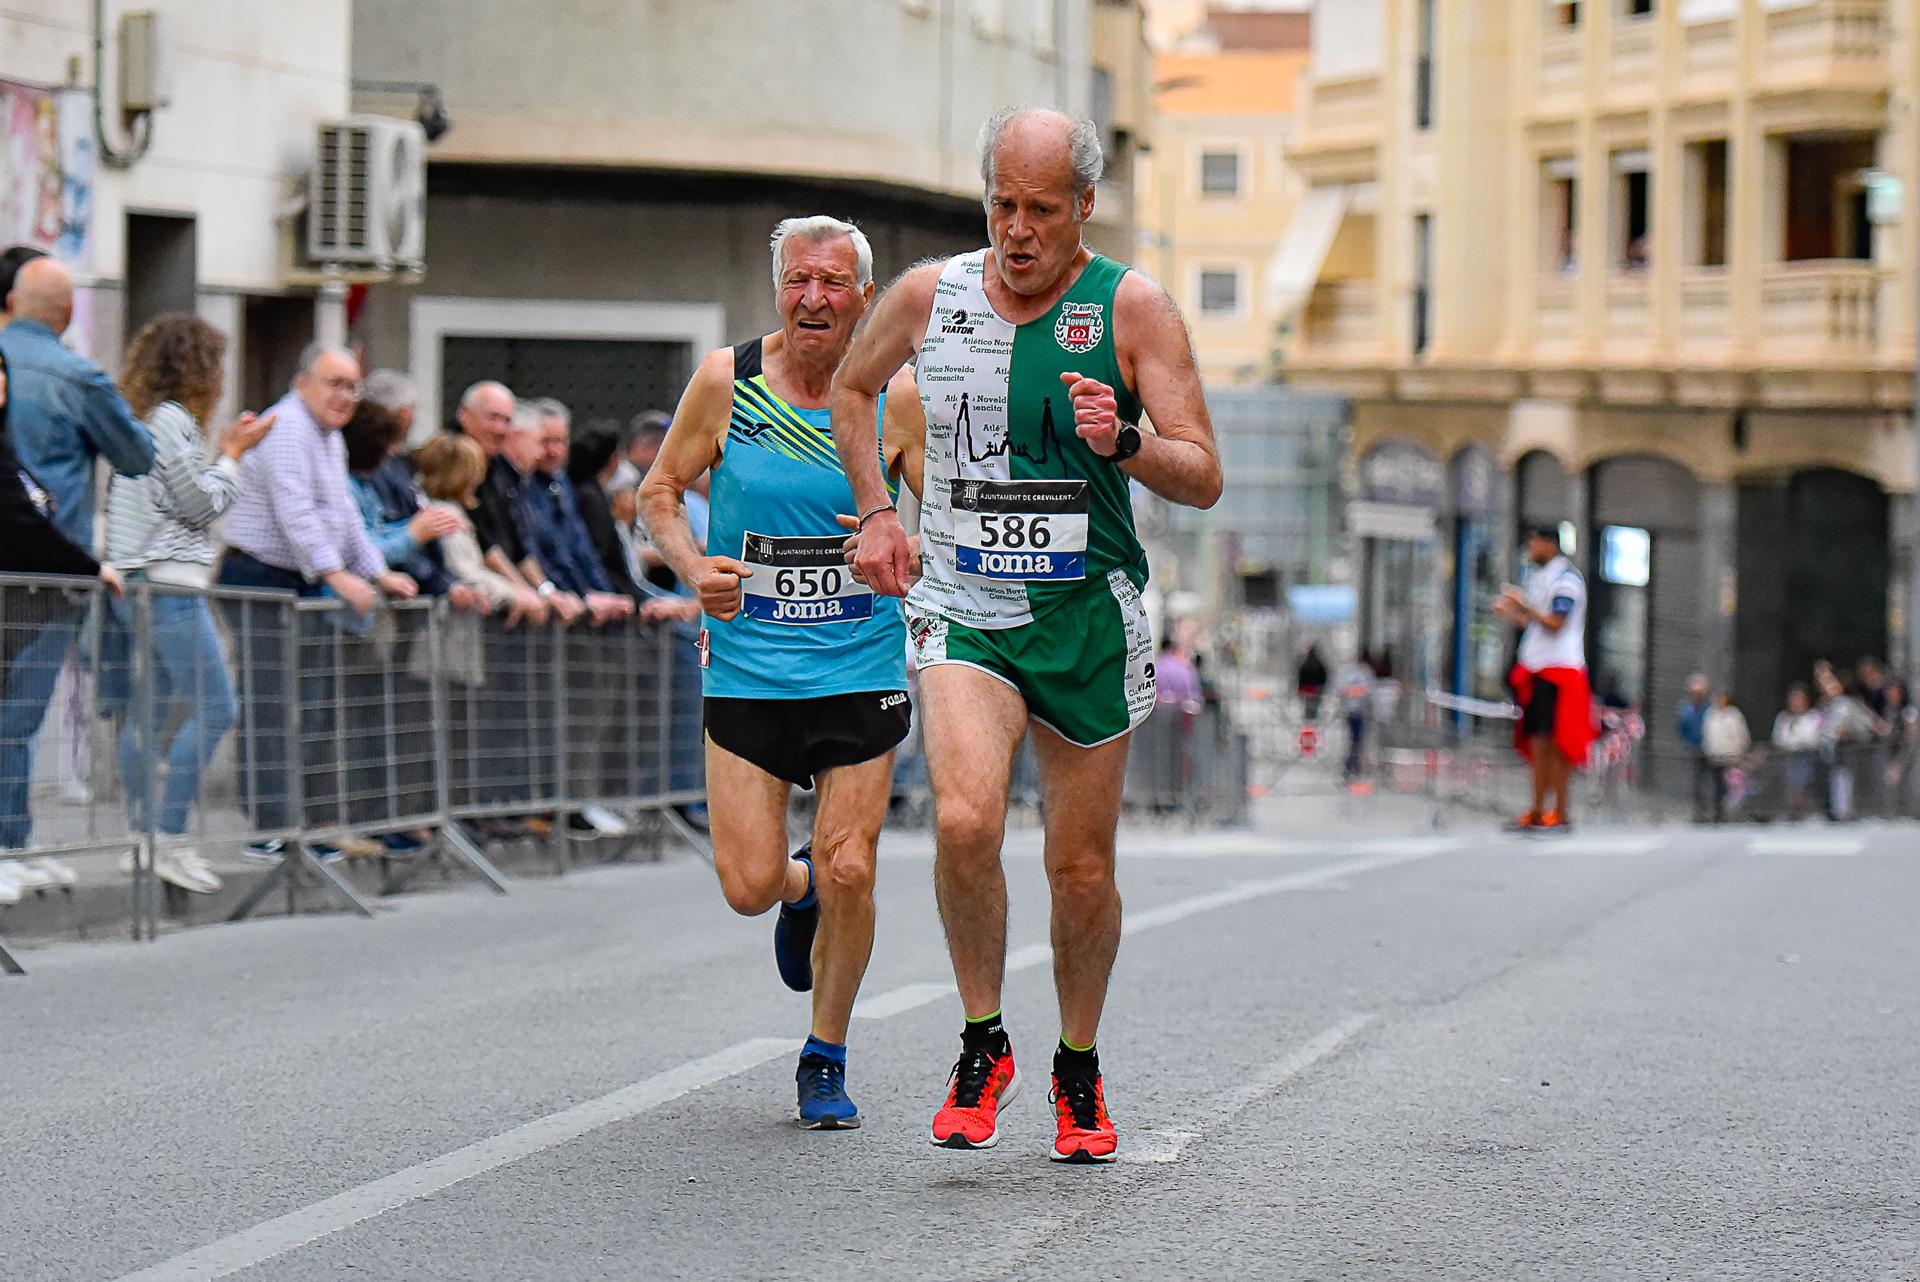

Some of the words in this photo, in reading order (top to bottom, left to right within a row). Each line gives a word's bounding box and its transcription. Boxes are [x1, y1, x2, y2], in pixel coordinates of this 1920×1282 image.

[942, 325, 975, 335] VIATOR
[962, 338, 992, 346] Atlético
[944, 365, 975, 373] Novelda
[926, 374, 965, 382] Carmencita
[980, 515, 1051, 549] 586
[977, 552, 1053, 574] Joma
[775, 568, 842, 597] 650
[772, 600, 843, 620] Joma
[965, 609, 997, 618] Novelda
